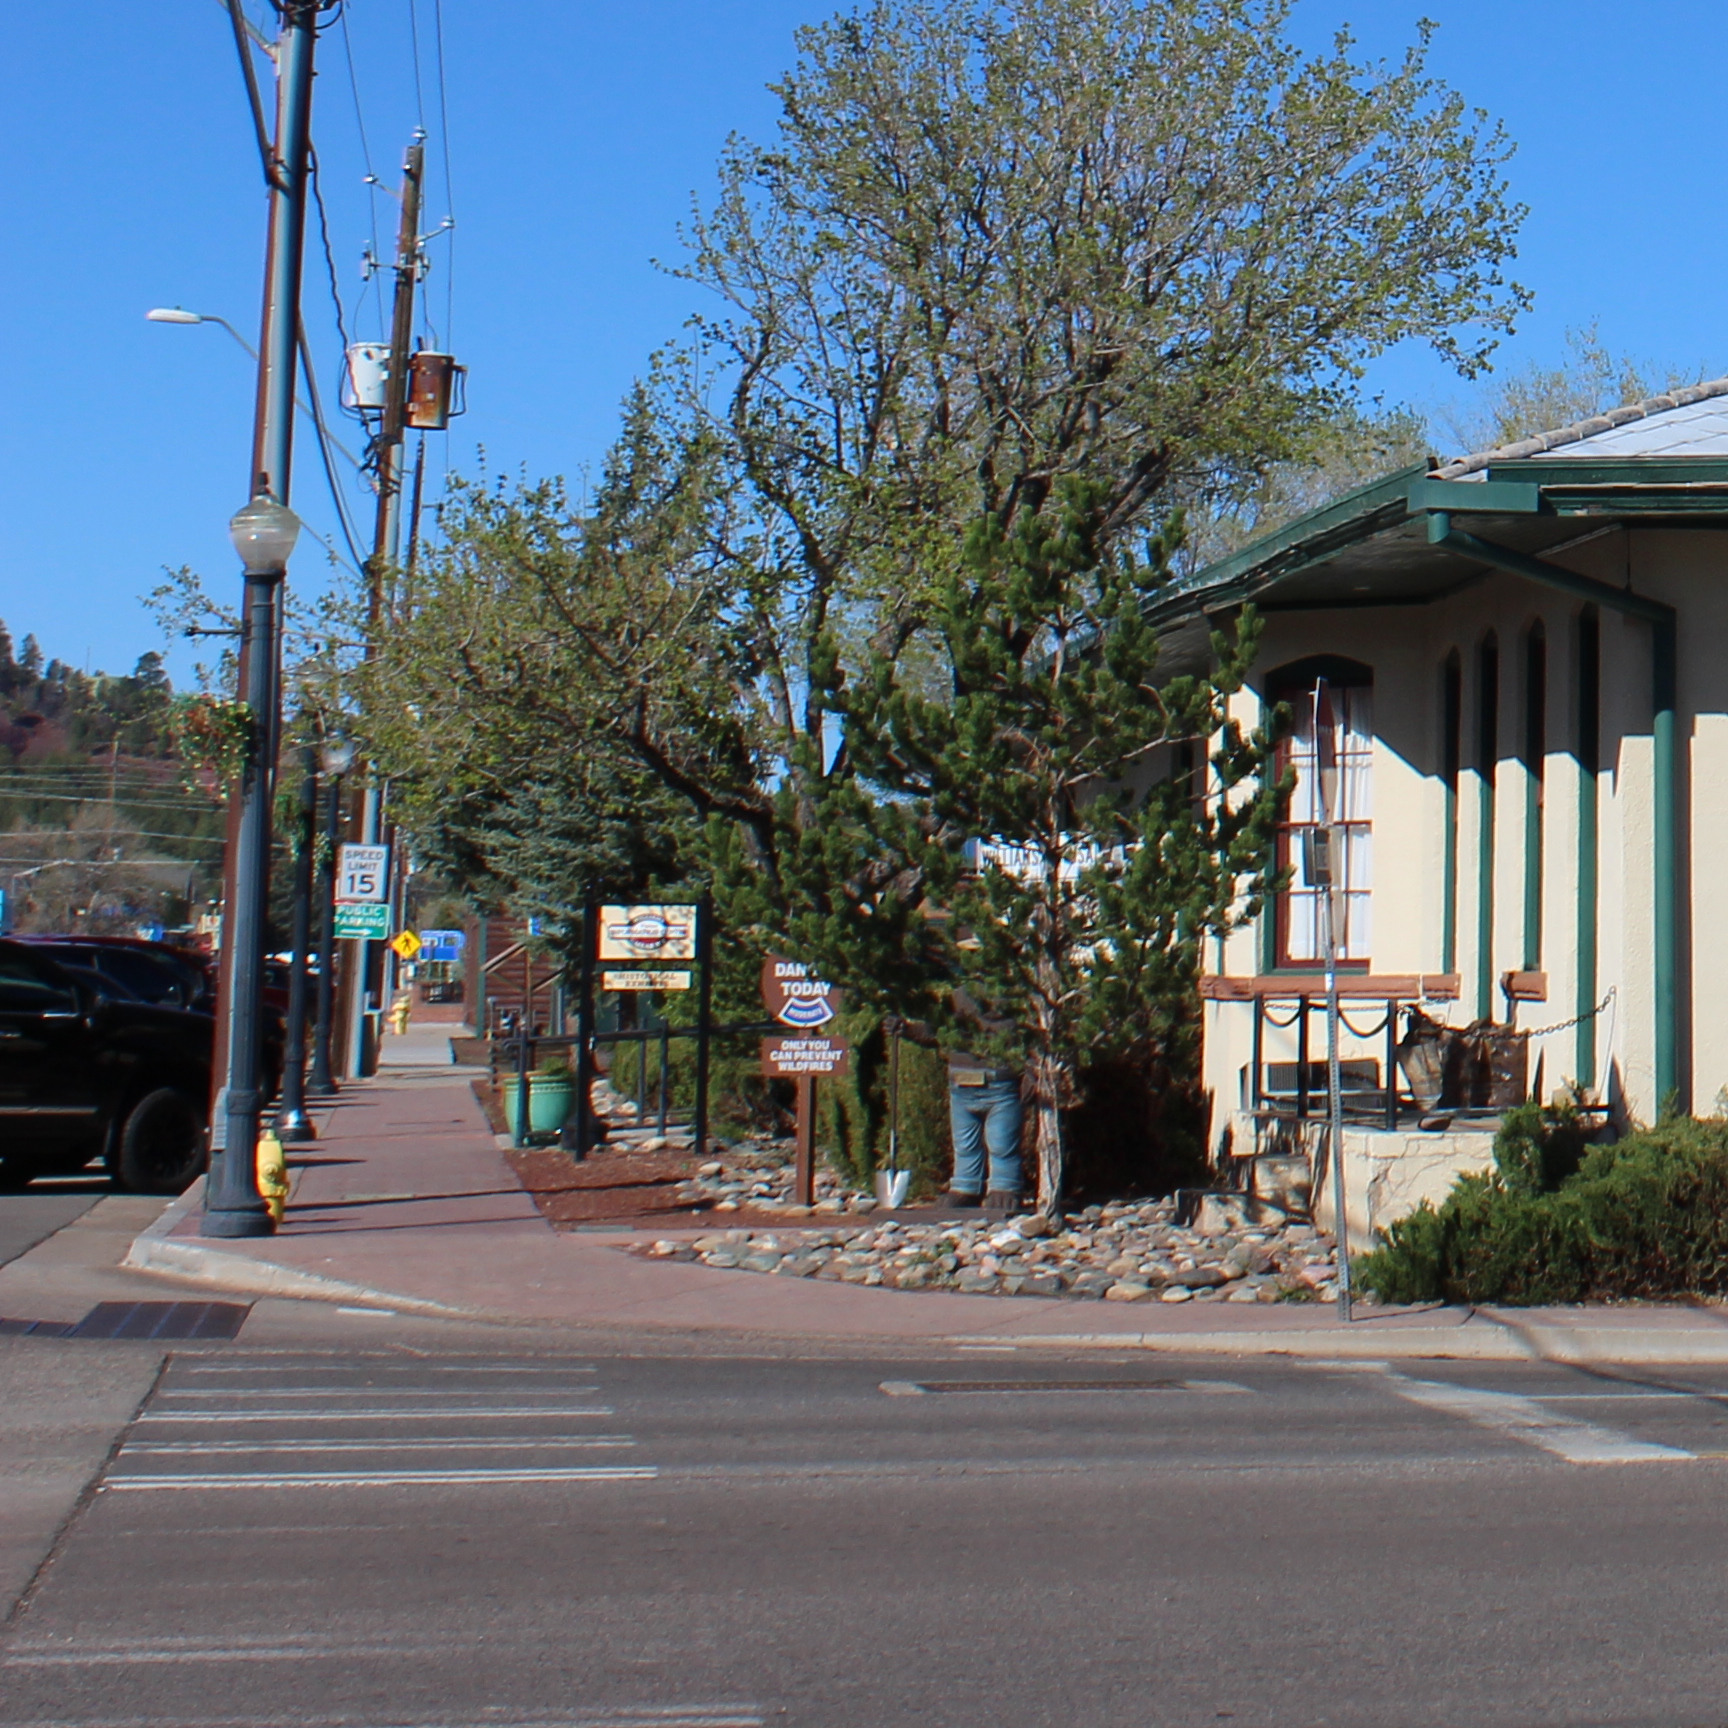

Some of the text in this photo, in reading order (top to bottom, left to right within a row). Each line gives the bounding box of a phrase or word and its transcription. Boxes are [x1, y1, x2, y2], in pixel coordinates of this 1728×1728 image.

[345, 849, 384, 861] SPEED
[347, 861, 379, 871] LIMIT
[347, 873, 376, 895] 15
[337, 905, 382, 917] PUBLIC
[334, 915, 386, 928] PARKING
[780, 981, 832, 997] TODAY
[781, 1039, 831, 1050] ONLY YOU
[769, 1050, 843, 1062] CAN PREVENT
[777, 1061, 834, 1073] WILDFIRES
